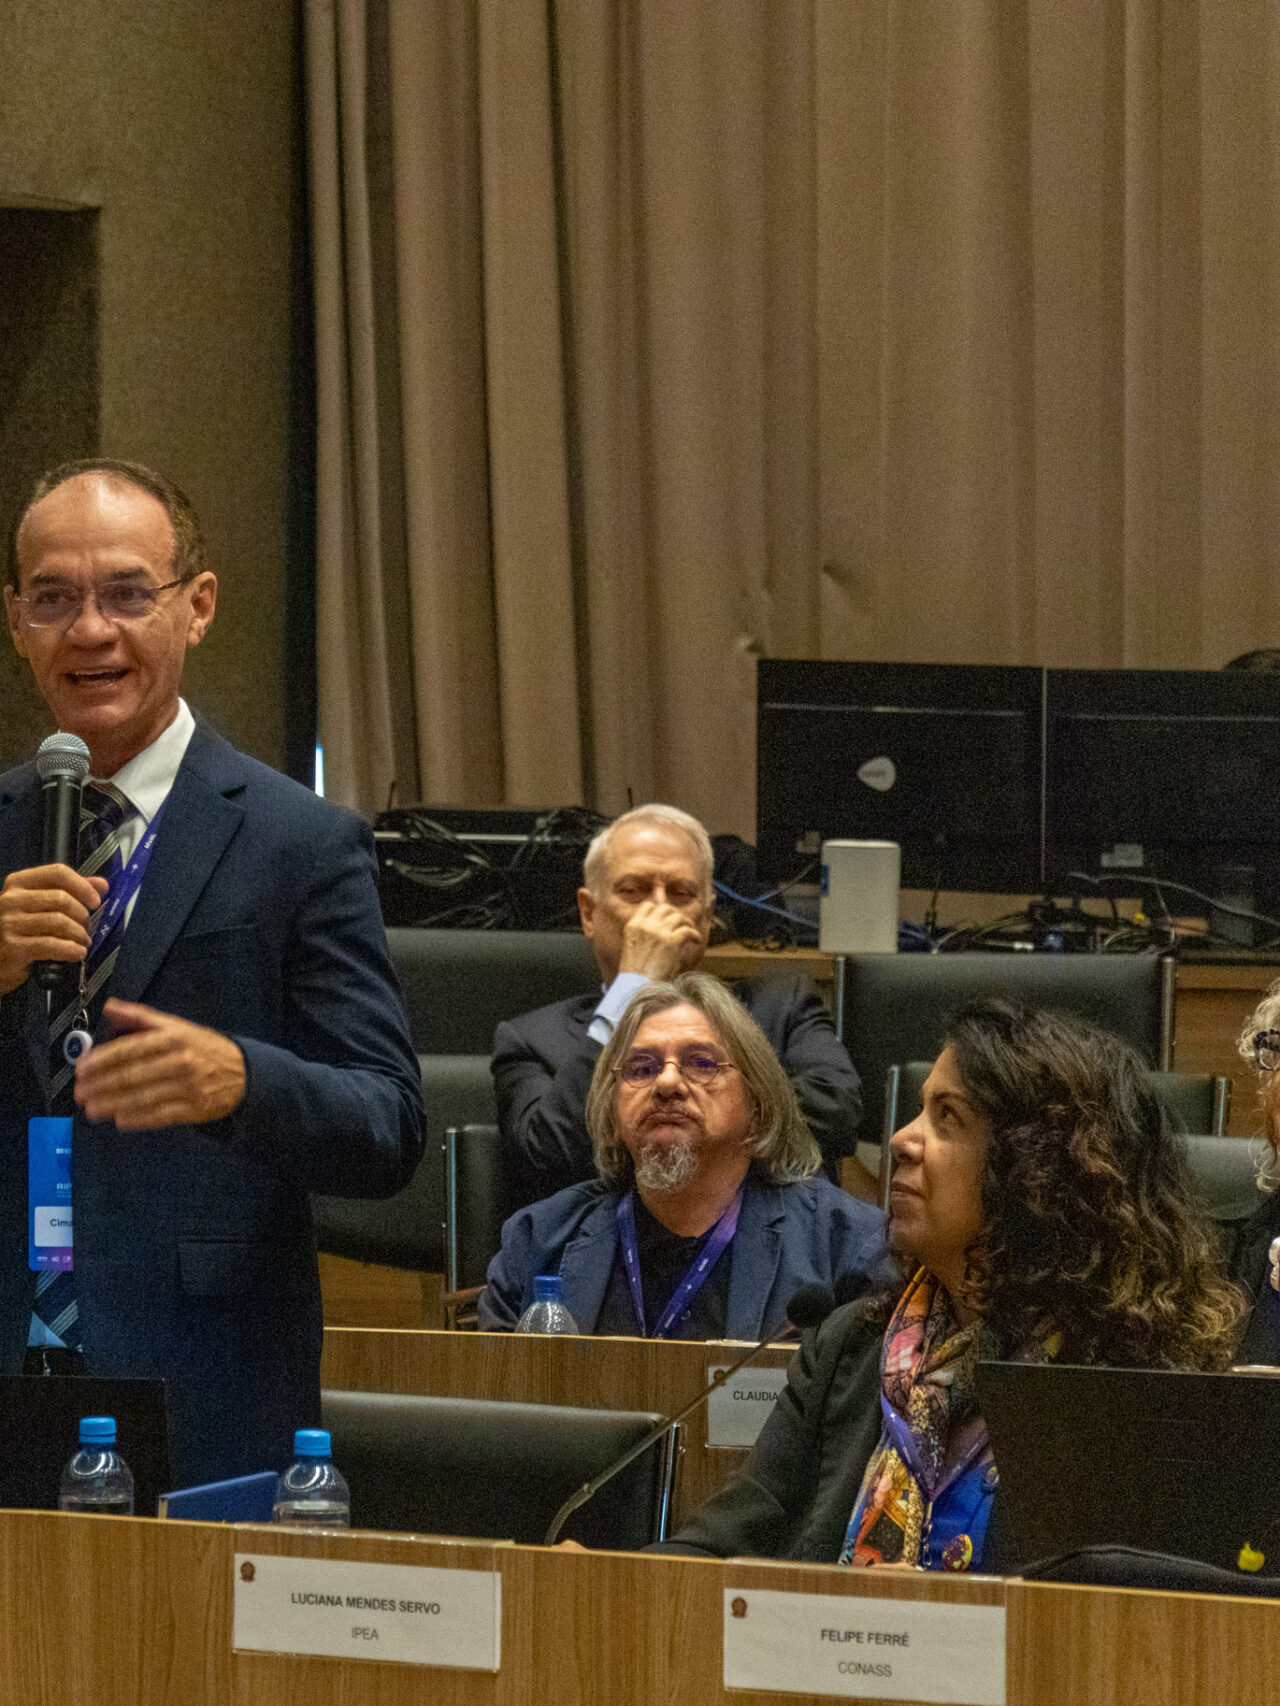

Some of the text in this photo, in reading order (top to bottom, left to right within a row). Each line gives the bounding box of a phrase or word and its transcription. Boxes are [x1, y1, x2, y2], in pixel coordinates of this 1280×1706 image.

[733, 1390, 779, 1401] CLAUDIA
[290, 1591, 441, 1616] LUCIANA MENDES SERVO
[351, 1627, 380, 1641] IPEA
[820, 1628, 910, 1648] FELIPE FERRÉ
[837, 1661, 893, 1678] CONASS
